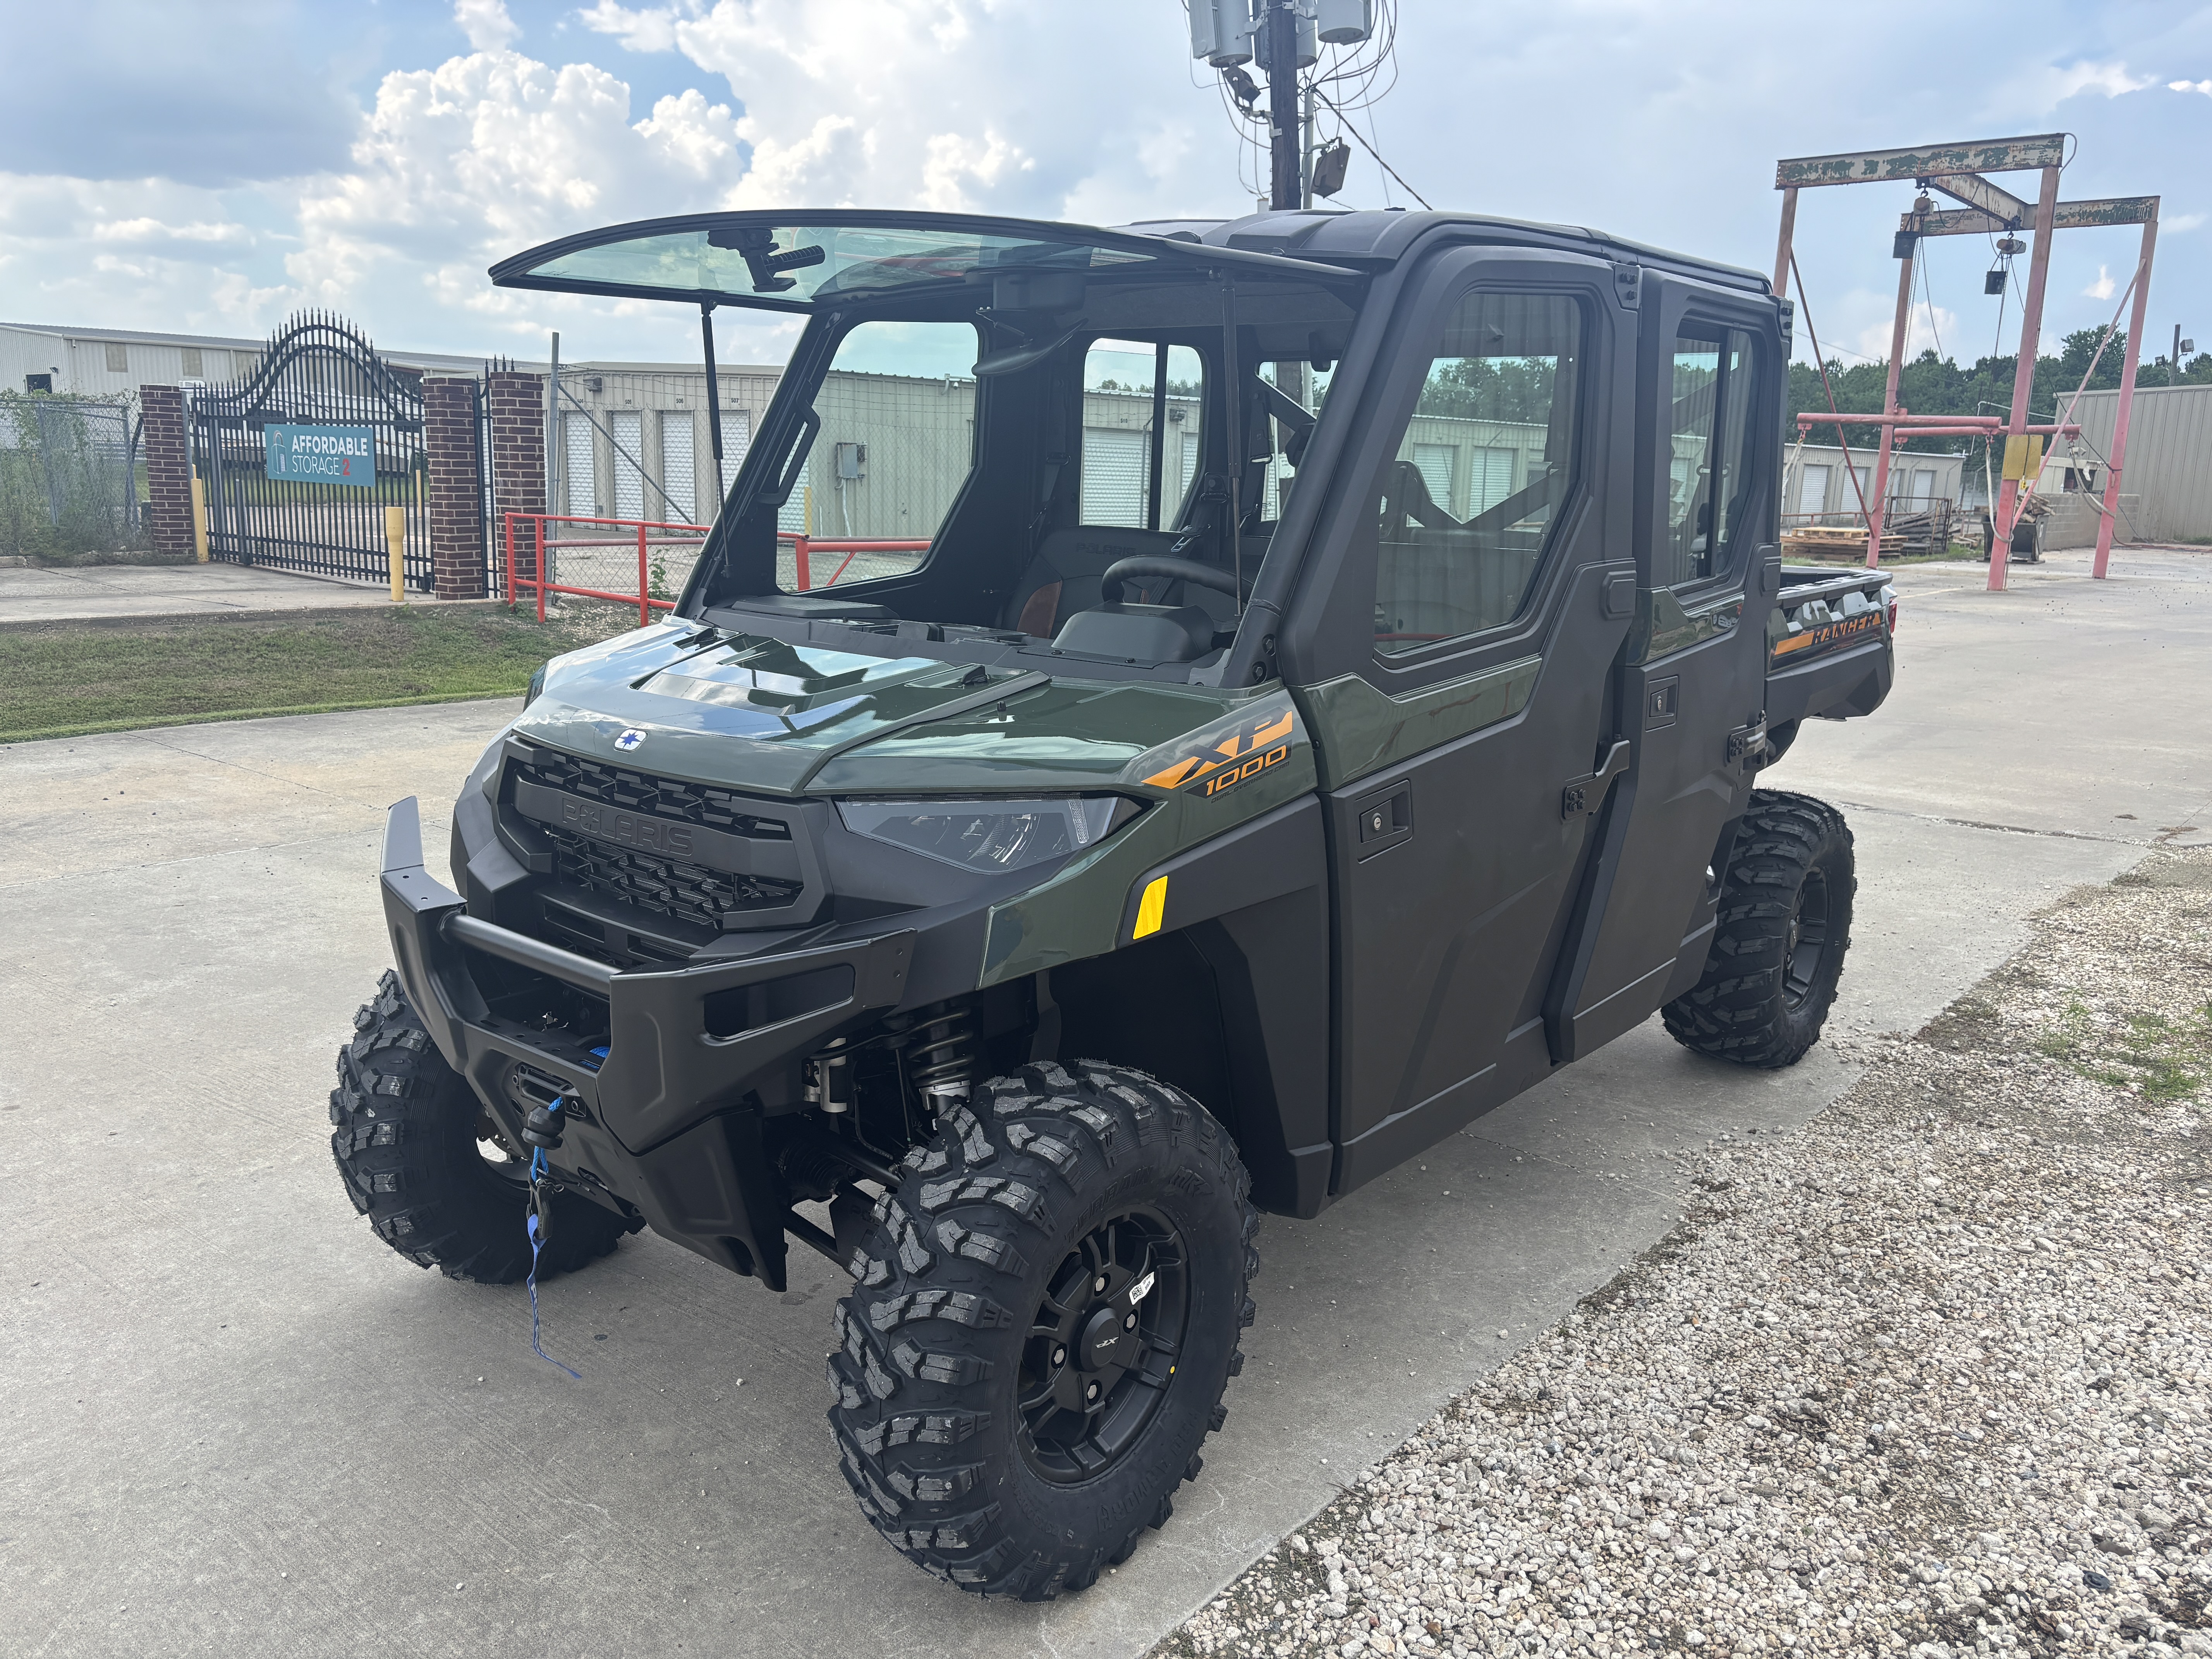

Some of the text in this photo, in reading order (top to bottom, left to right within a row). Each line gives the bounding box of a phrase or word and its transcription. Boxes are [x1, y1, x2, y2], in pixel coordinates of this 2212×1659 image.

[292, 435, 368, 456] AFFORDABLE
[292, 455, 350, 476] STORAGE 2
[1206, 745, 1286, 796] 1000
[562, 797, 693, 857] POLARIS
